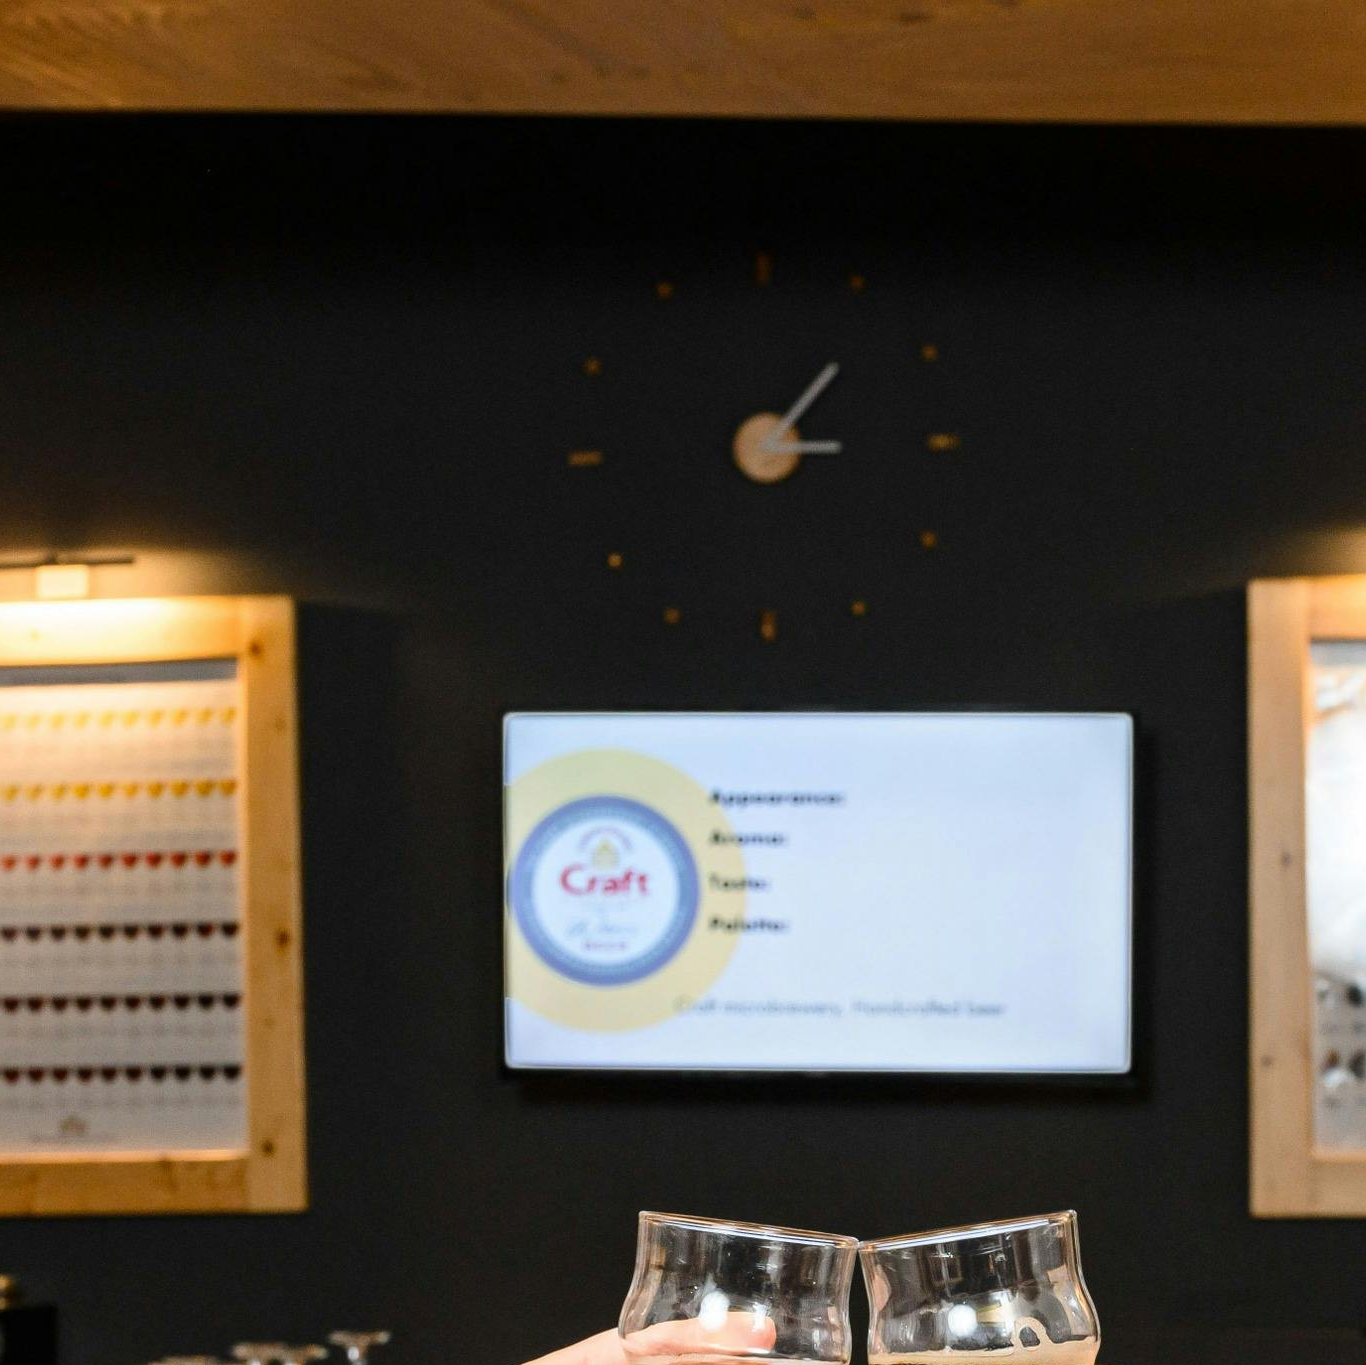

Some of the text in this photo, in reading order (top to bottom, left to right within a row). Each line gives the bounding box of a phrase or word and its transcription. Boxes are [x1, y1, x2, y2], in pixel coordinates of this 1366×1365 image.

[709, 830, 788, 845] Aroma:
[560, 864, 649, 896] Craft
[709, 873, 769, 891] Taste:
